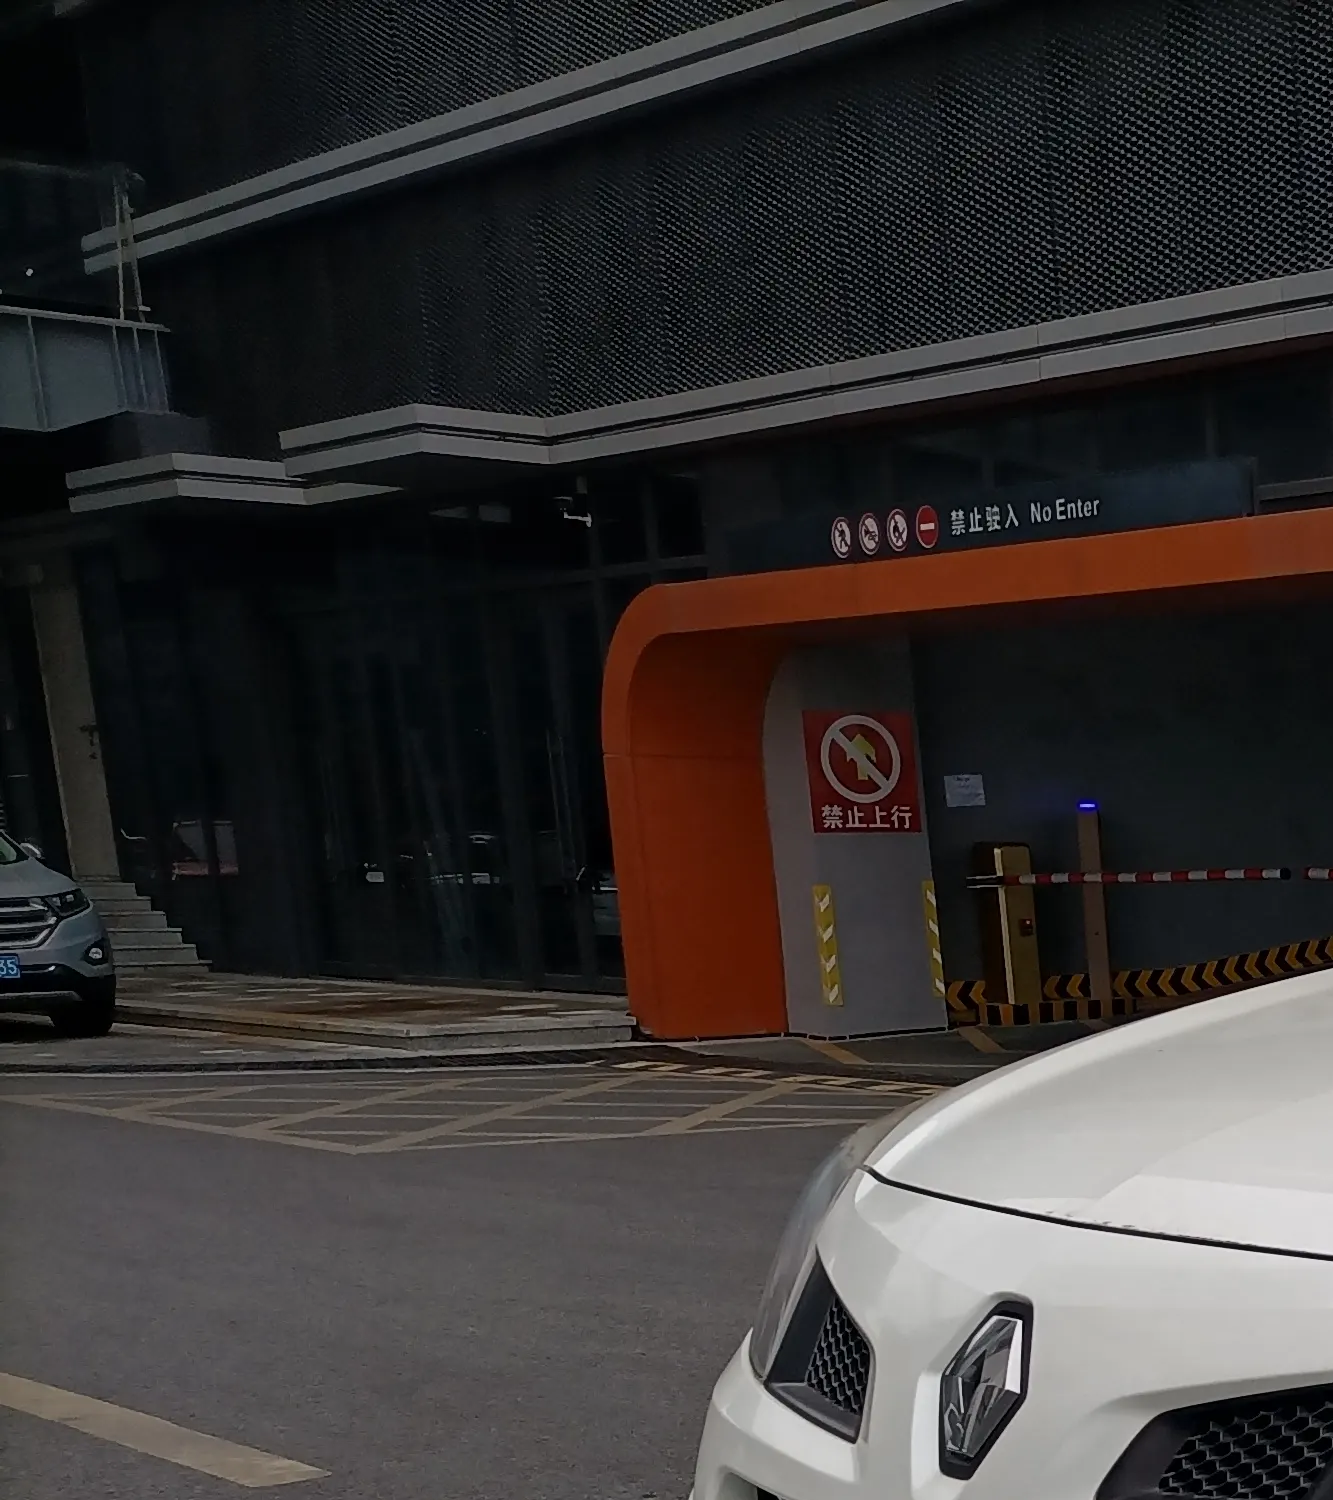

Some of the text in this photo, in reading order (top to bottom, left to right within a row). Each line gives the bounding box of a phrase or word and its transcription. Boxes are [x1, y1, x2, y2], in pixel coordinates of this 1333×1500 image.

[950, 498, 1100, 536] 禁止驶入 No Enter
[821, 804, 913, 829] 禁止上行
